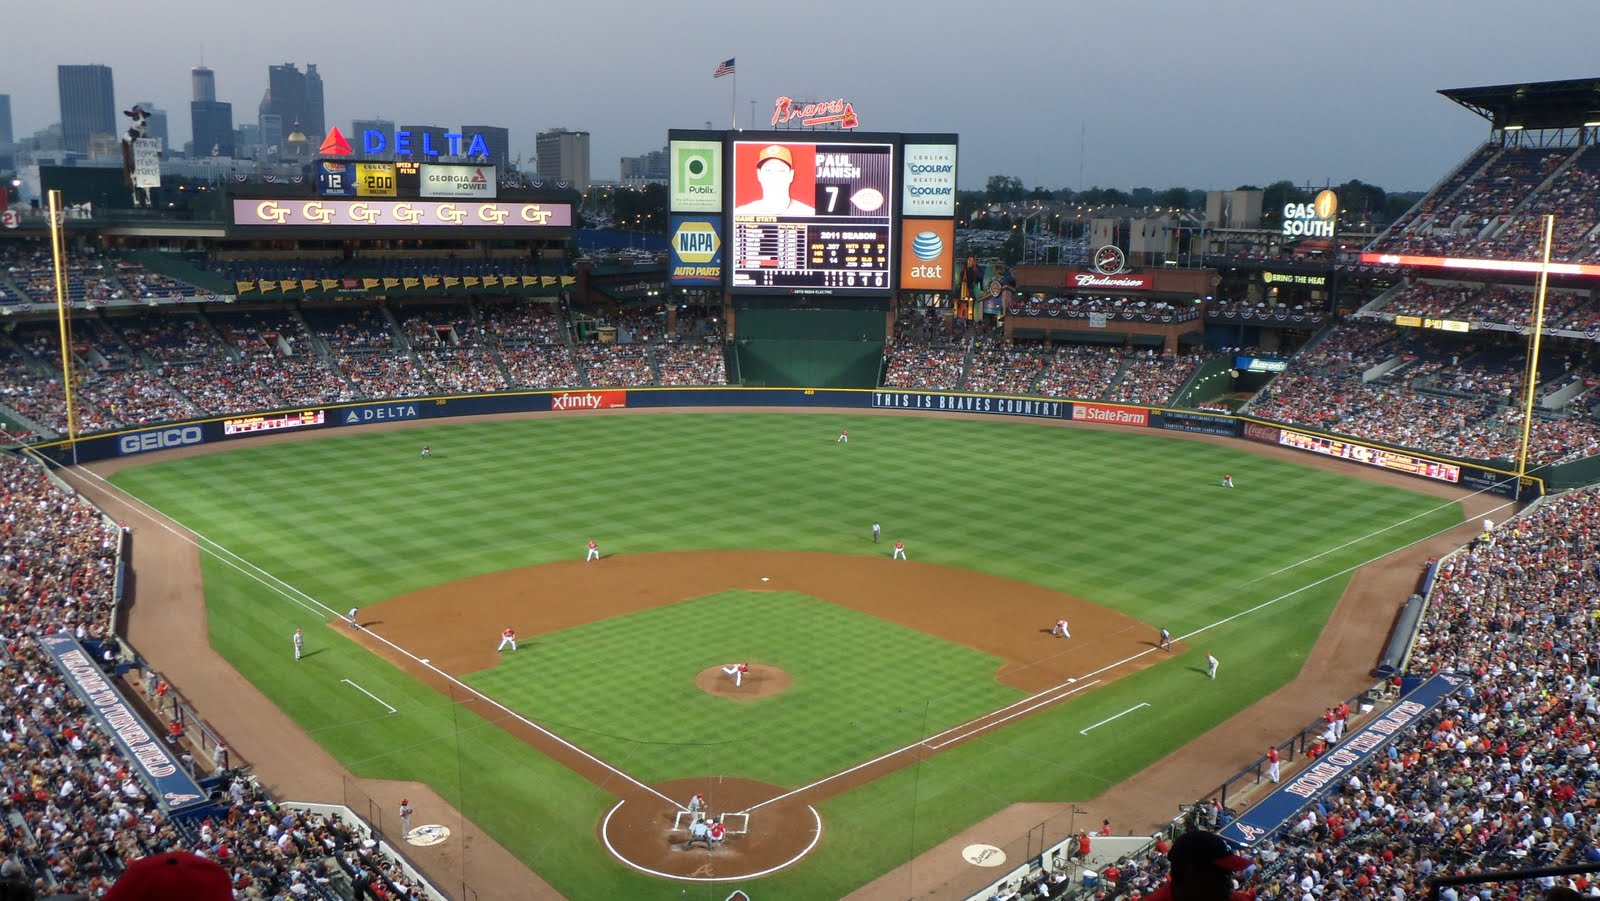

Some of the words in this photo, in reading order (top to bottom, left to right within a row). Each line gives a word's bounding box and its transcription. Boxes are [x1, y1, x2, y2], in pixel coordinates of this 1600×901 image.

[772, 96, 844, 126] Braves
[364, 130, 490, 156] DELTA
[816, 154, 852, 166] PAUL
[816, 167, 860, 178] JANISH
[826, 187, 838, 212] 7
[4, 213, 21, 224] 21
[257, 201, 291, 224] GT
[302, 202, 335, 224] GT
[349, 203, 380, 224] GT
[392, 203, 423, 224] GT
[436, 203, 467, 224] GT
[478, 204, 508, 224] GT
[521, 205, 551, 224] GT
[1284, 203, 1315, 218] GAS
[1283, 220, 1334, 236] SOUTH
[681, 233, 712, 251] NAPA
[674, 266, 695, 276] AUTO
[696, 267, 720, 276] PARTS
[911, 265, 942, 278] at&t
[1272, 274, 1293, 282] BRING
[847, 276, 855, 286] 0
[862, 276, 868, 286] 1
[875, 276, 882, 286] 0
[1075, 275, 1143, 286] Budweiser
[1249, 359, 1288, 371] Aaron's
[553, 393, 602, 410] xfinity
[876, 393, 909, 406] THIS
[917, 395, 931, 408] IS
[940, 396, 990, 411] BRAVES
[998, 399, 1059, 416] COUNTRY
[364, 406, 416, 420] DELTA
[121, 427, 202, 453] GEICO
[58, 649, 109, 697] WELCOME
[90, 690, 119, 706] TO
[100, 703, 150, 747] TURNER
[1368, 700, 1425, 735] BRAVES
[1343, 731, 1386, 753] THE
[130, 741, 176, 777] FIELD
[1328, 748, 1360, 766] OF
[1284, 762, 1344, 798] HOME
